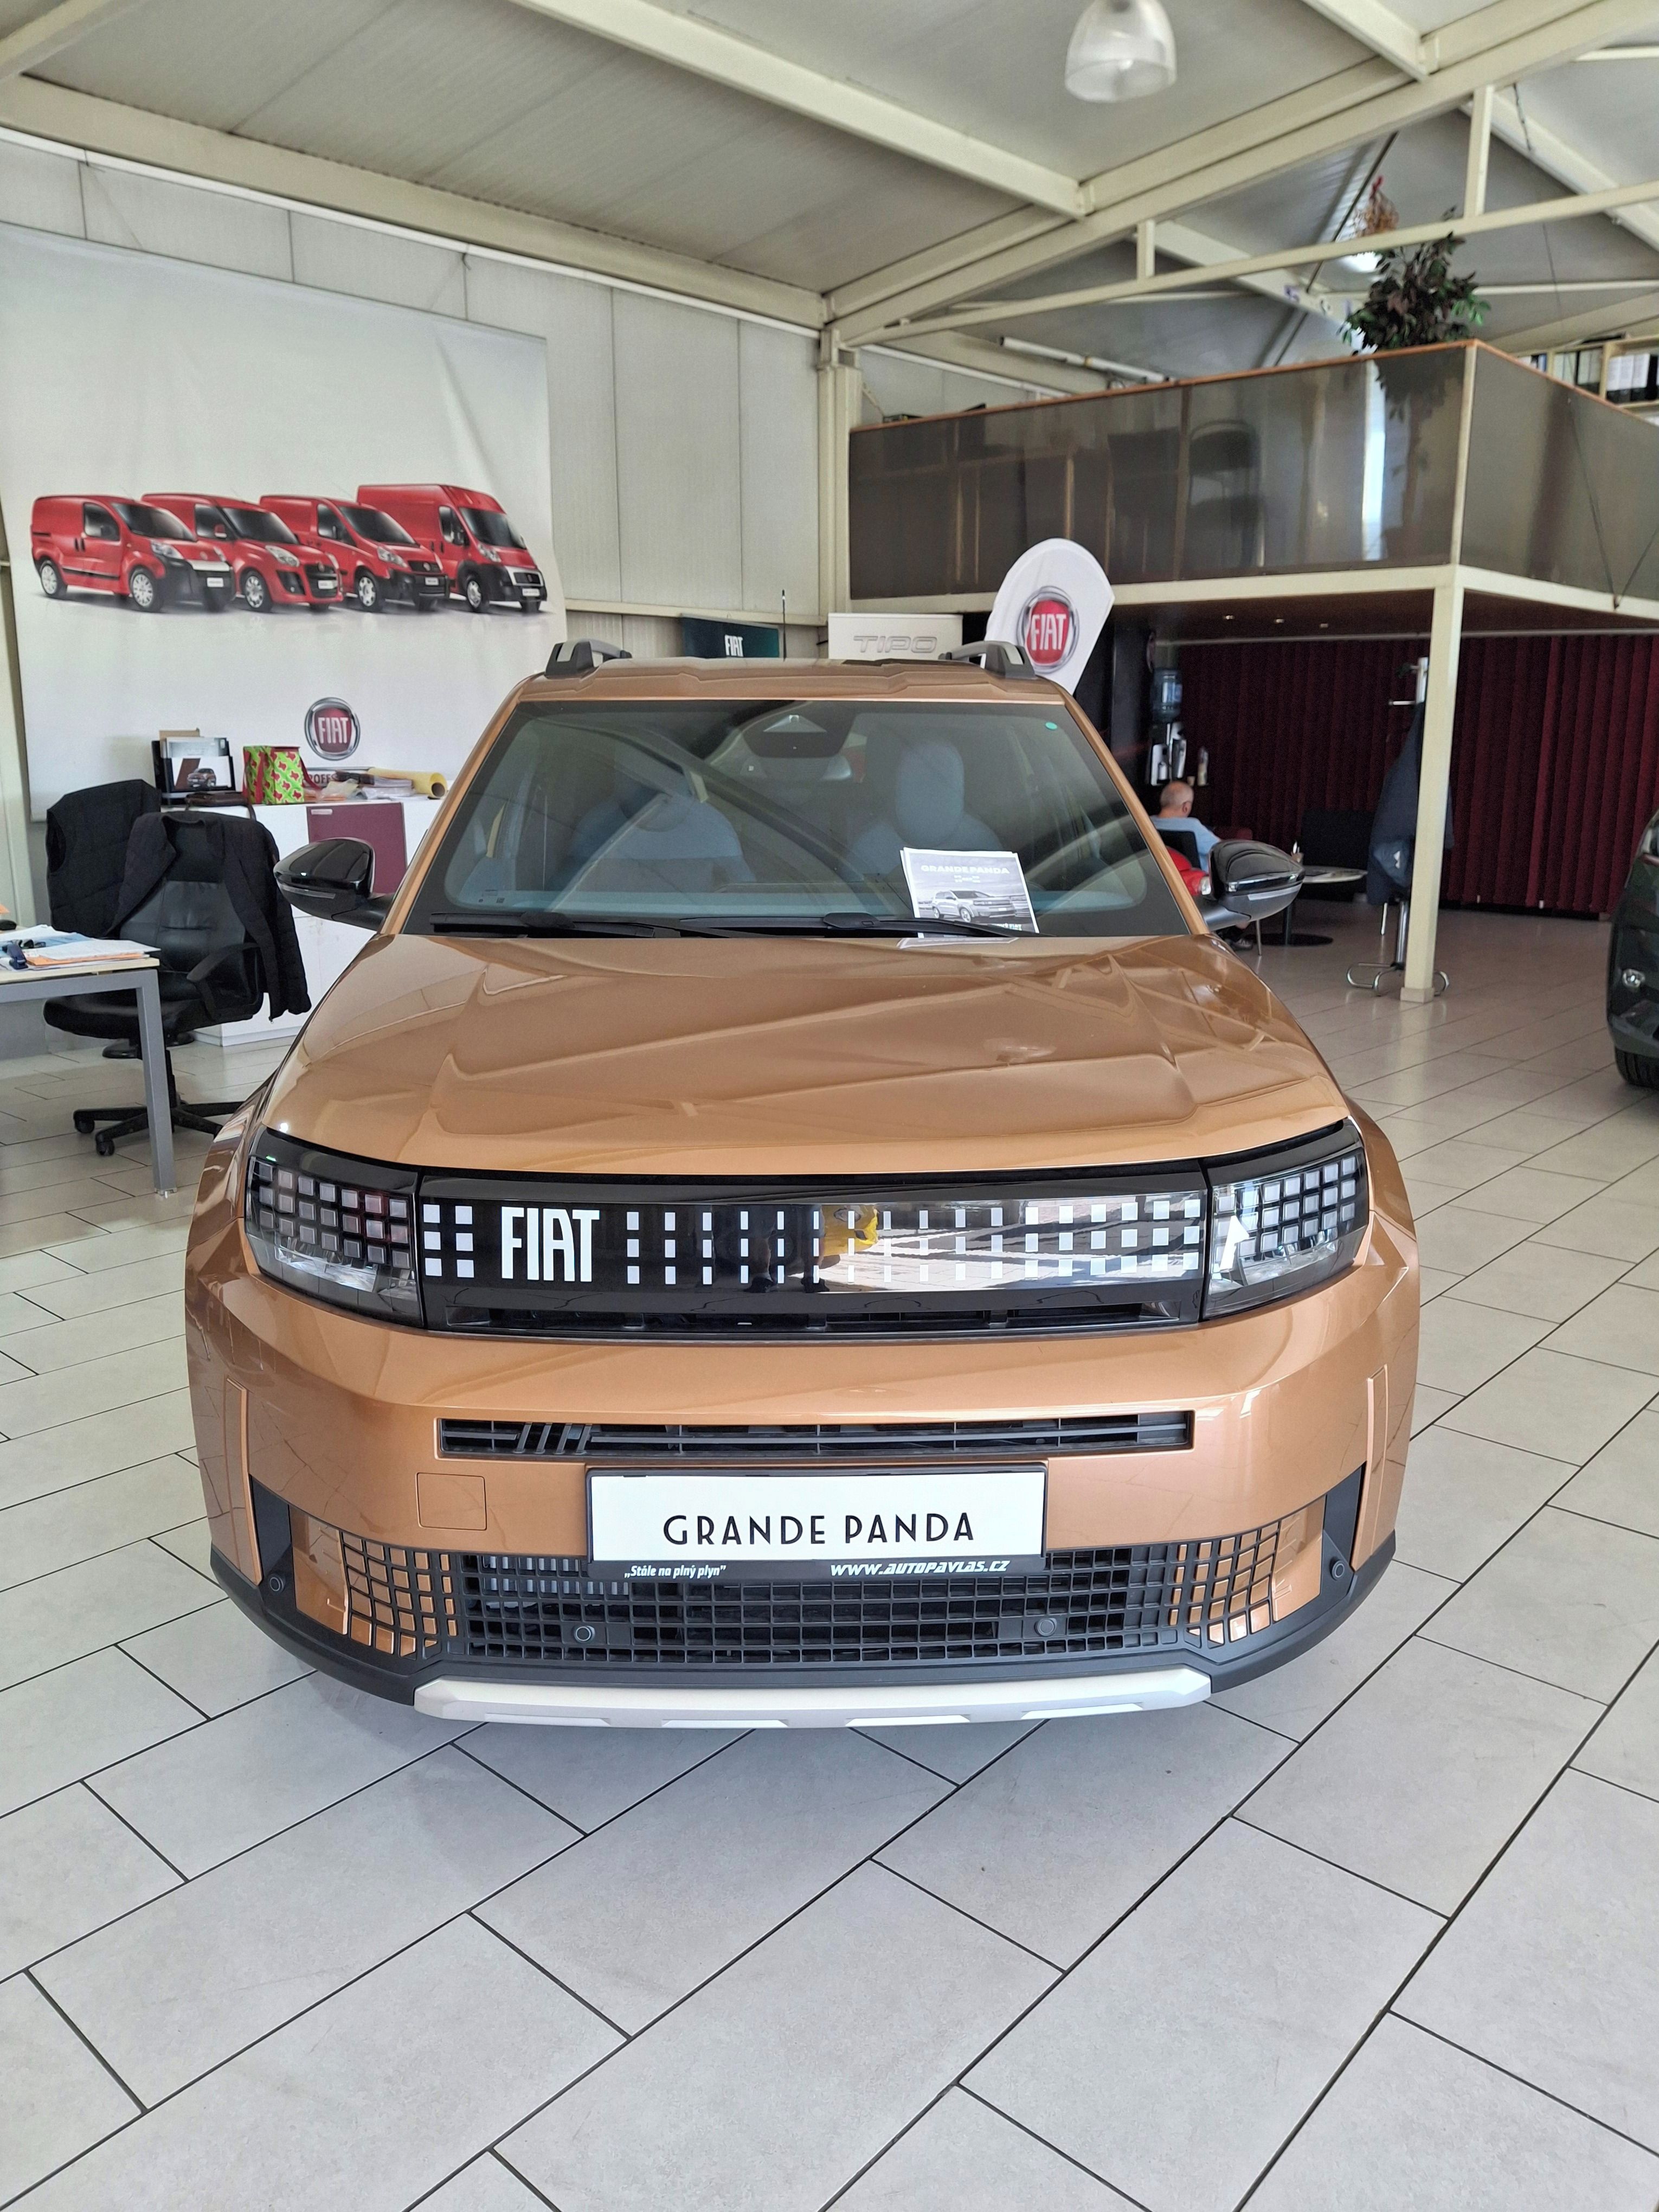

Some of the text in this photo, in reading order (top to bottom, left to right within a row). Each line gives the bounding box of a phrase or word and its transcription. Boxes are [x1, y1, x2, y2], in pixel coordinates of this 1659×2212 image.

[853, 635, 937, 653] TIPO
[1031, 613, 1066, 651] FIAT
[724, 634, 743, 657] FIAT
[318, 717, 349, 744] FIAT
[921, 865, 968, 873] GRANDE
[501, 1206, 600, 1282] FIAT
[663, 1513, 974, 1545] GRANDE PANDA
[658, 1566, 672, 1576] na
[673, 1565, 697, 1579] plný
